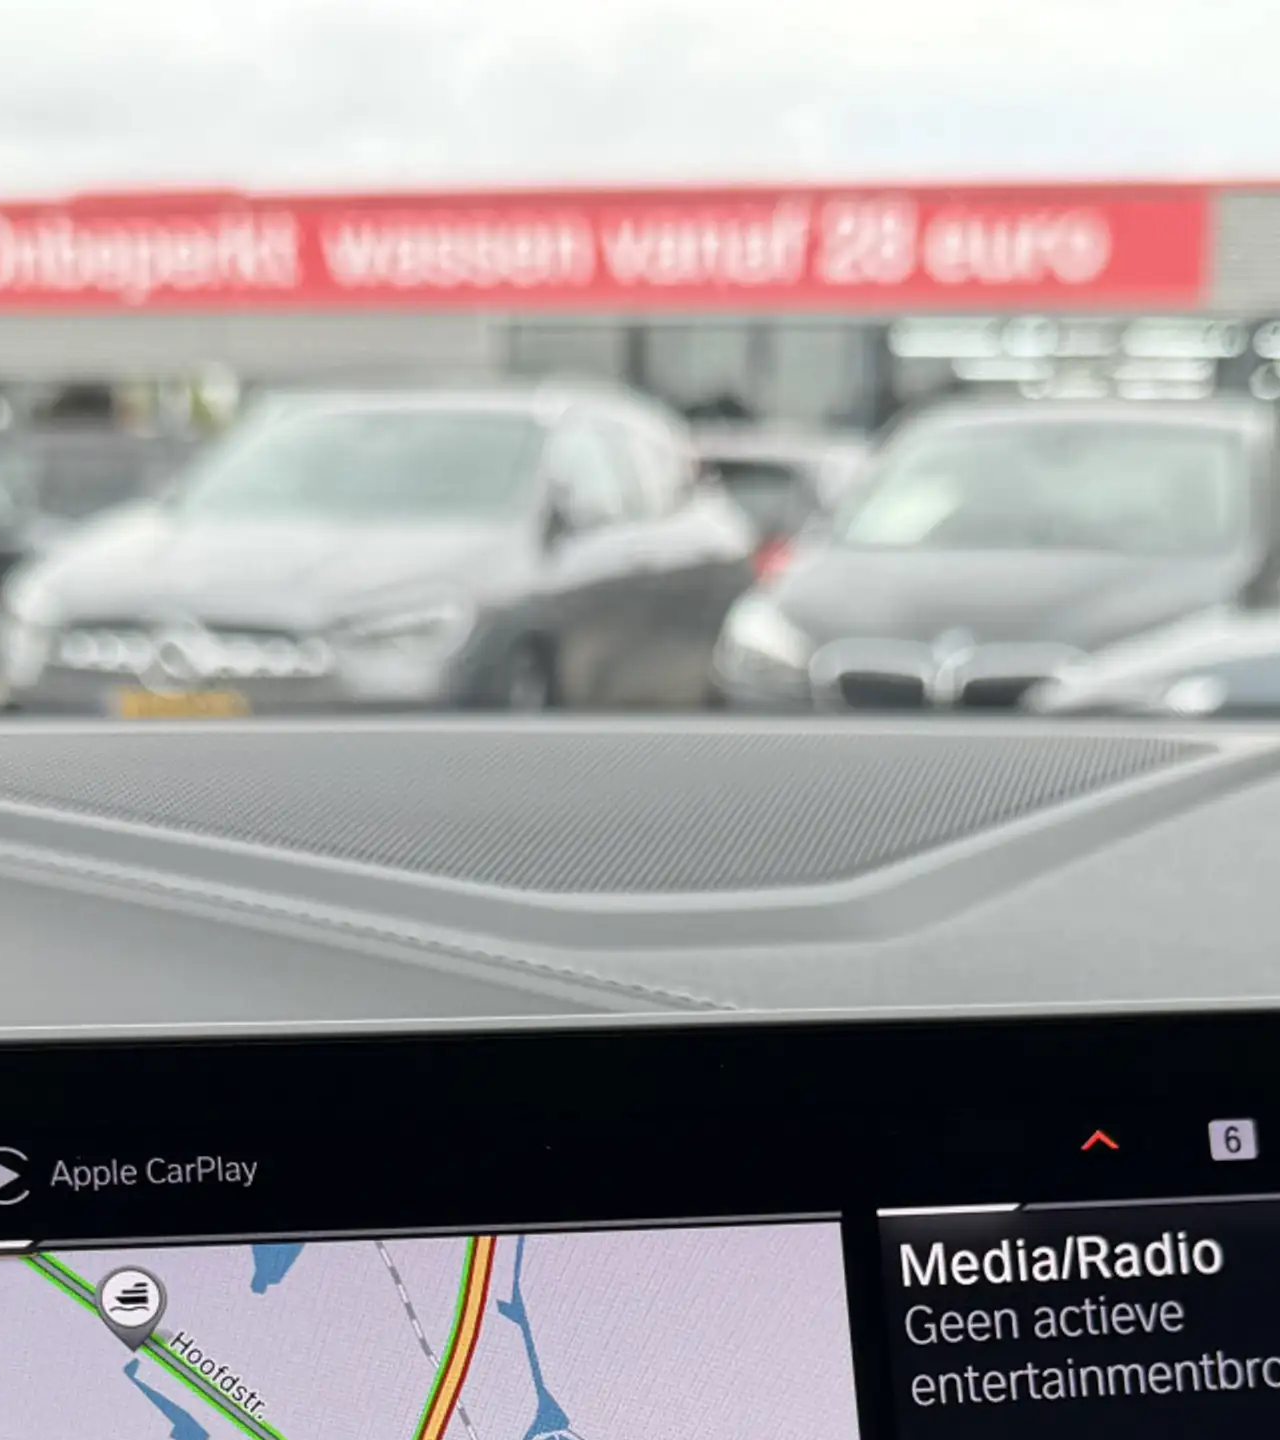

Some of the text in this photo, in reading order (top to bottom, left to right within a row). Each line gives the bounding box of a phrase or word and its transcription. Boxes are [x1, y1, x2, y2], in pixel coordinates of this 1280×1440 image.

[322, 213, 594, 288] wassen
[604, 196, 811, 286] vanaf
[818, 194, 918, 285] 28
[924, 206, 1112, 285] euro
[1223, 1125, 1241, 1154] 6
[50, 1156, 258, 1192] Apple CarPlay
[899, 1231, 1224, 1287] Media/Radio
[904, 1295, 1186, 1346] Geen actieve
[168, 1330, 268, 1419] Hoofdstr.
